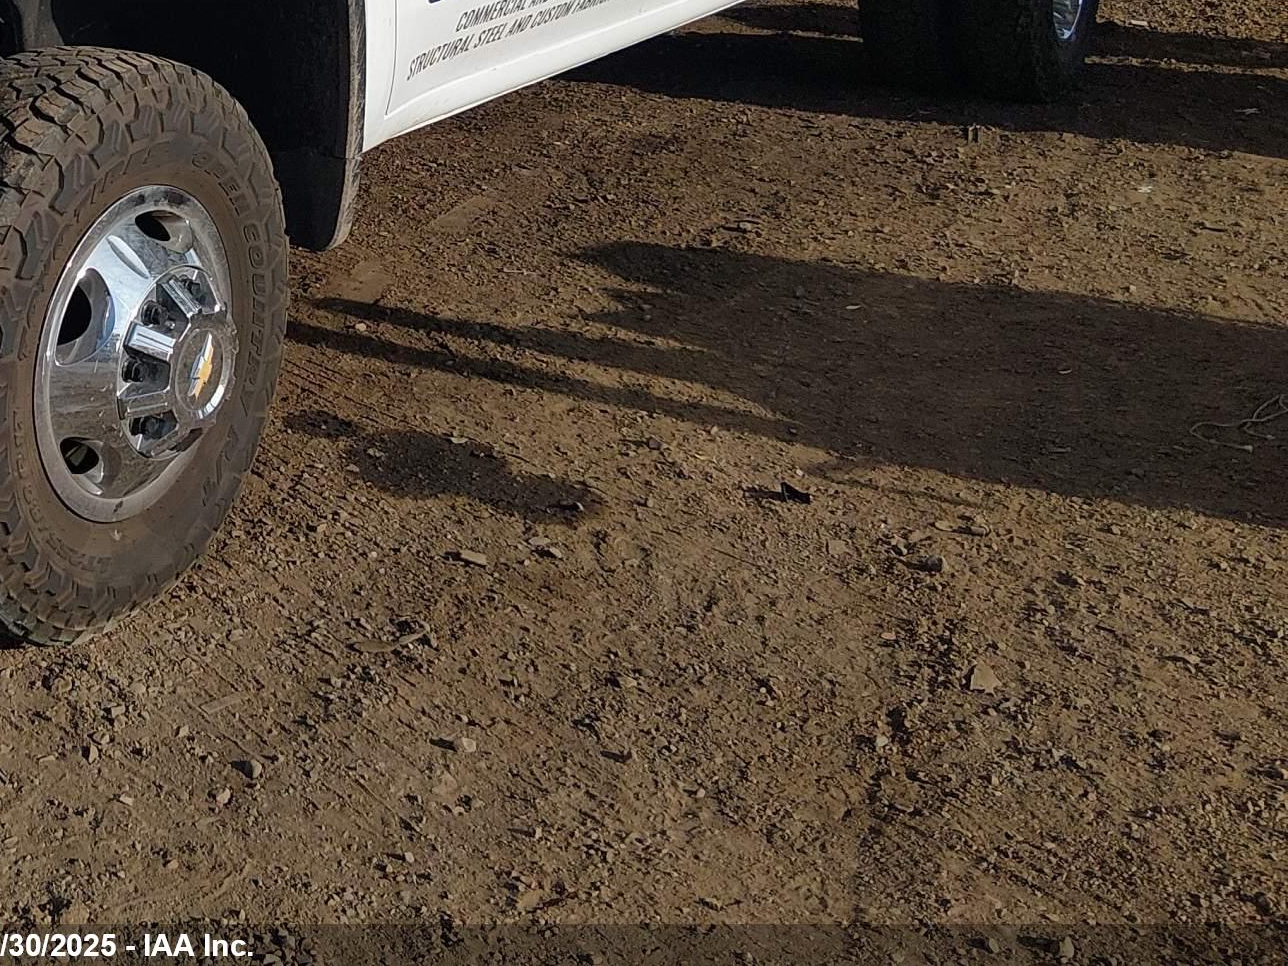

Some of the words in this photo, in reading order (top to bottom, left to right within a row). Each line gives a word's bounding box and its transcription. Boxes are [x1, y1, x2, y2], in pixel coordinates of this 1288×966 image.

[407, 33, 475, 81] STRUCTURAL
[473, 22, 507, 49] STEEL
[505, 15, 532, 38] AND
[530, 0, 576, 29] CUSTOM
